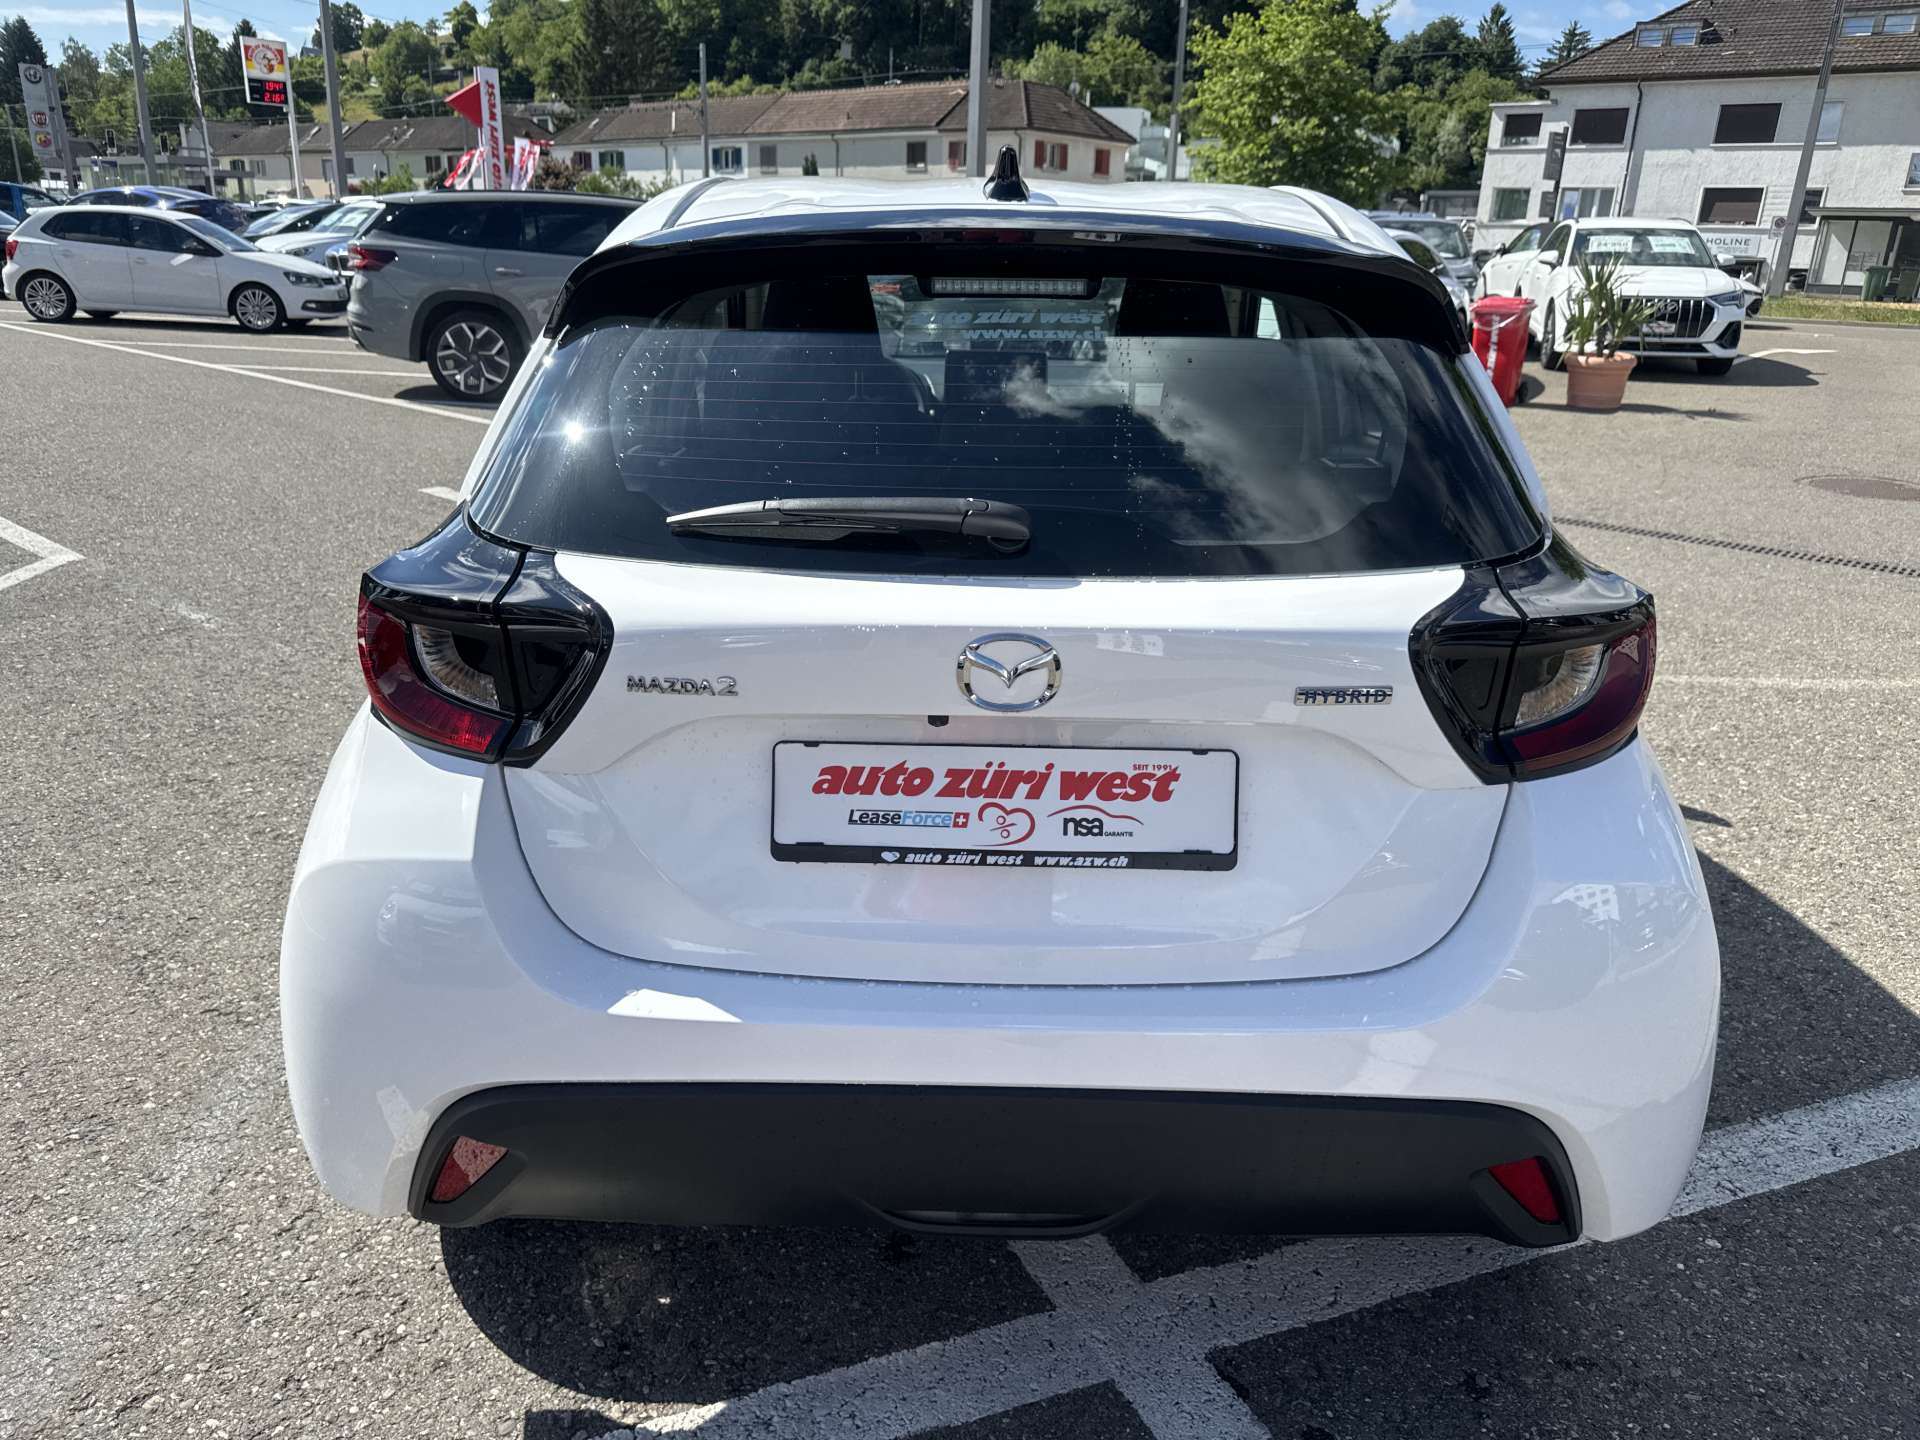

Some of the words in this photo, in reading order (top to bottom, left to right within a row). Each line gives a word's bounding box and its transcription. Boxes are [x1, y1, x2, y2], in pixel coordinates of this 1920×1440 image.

[974, 309, 1037, 324] züri
[1039, 311, 1107, 324] west
[1303, 689, 1388, 704] HYBRID
[811, 760, 935, 797] auto
[934, 761, 1055, 799] züri
[1059, 766, 1182, 802] west
[847, 809, 953, 828] LeaseForce
[1063, 817, 1104, 837] nsa
[905, 852, 943, 864] auto
[946, 852, 983, 865] züri
[986, 854, 1024, 866] west
[1034, 855, 1129, 868] www.azw.ch
